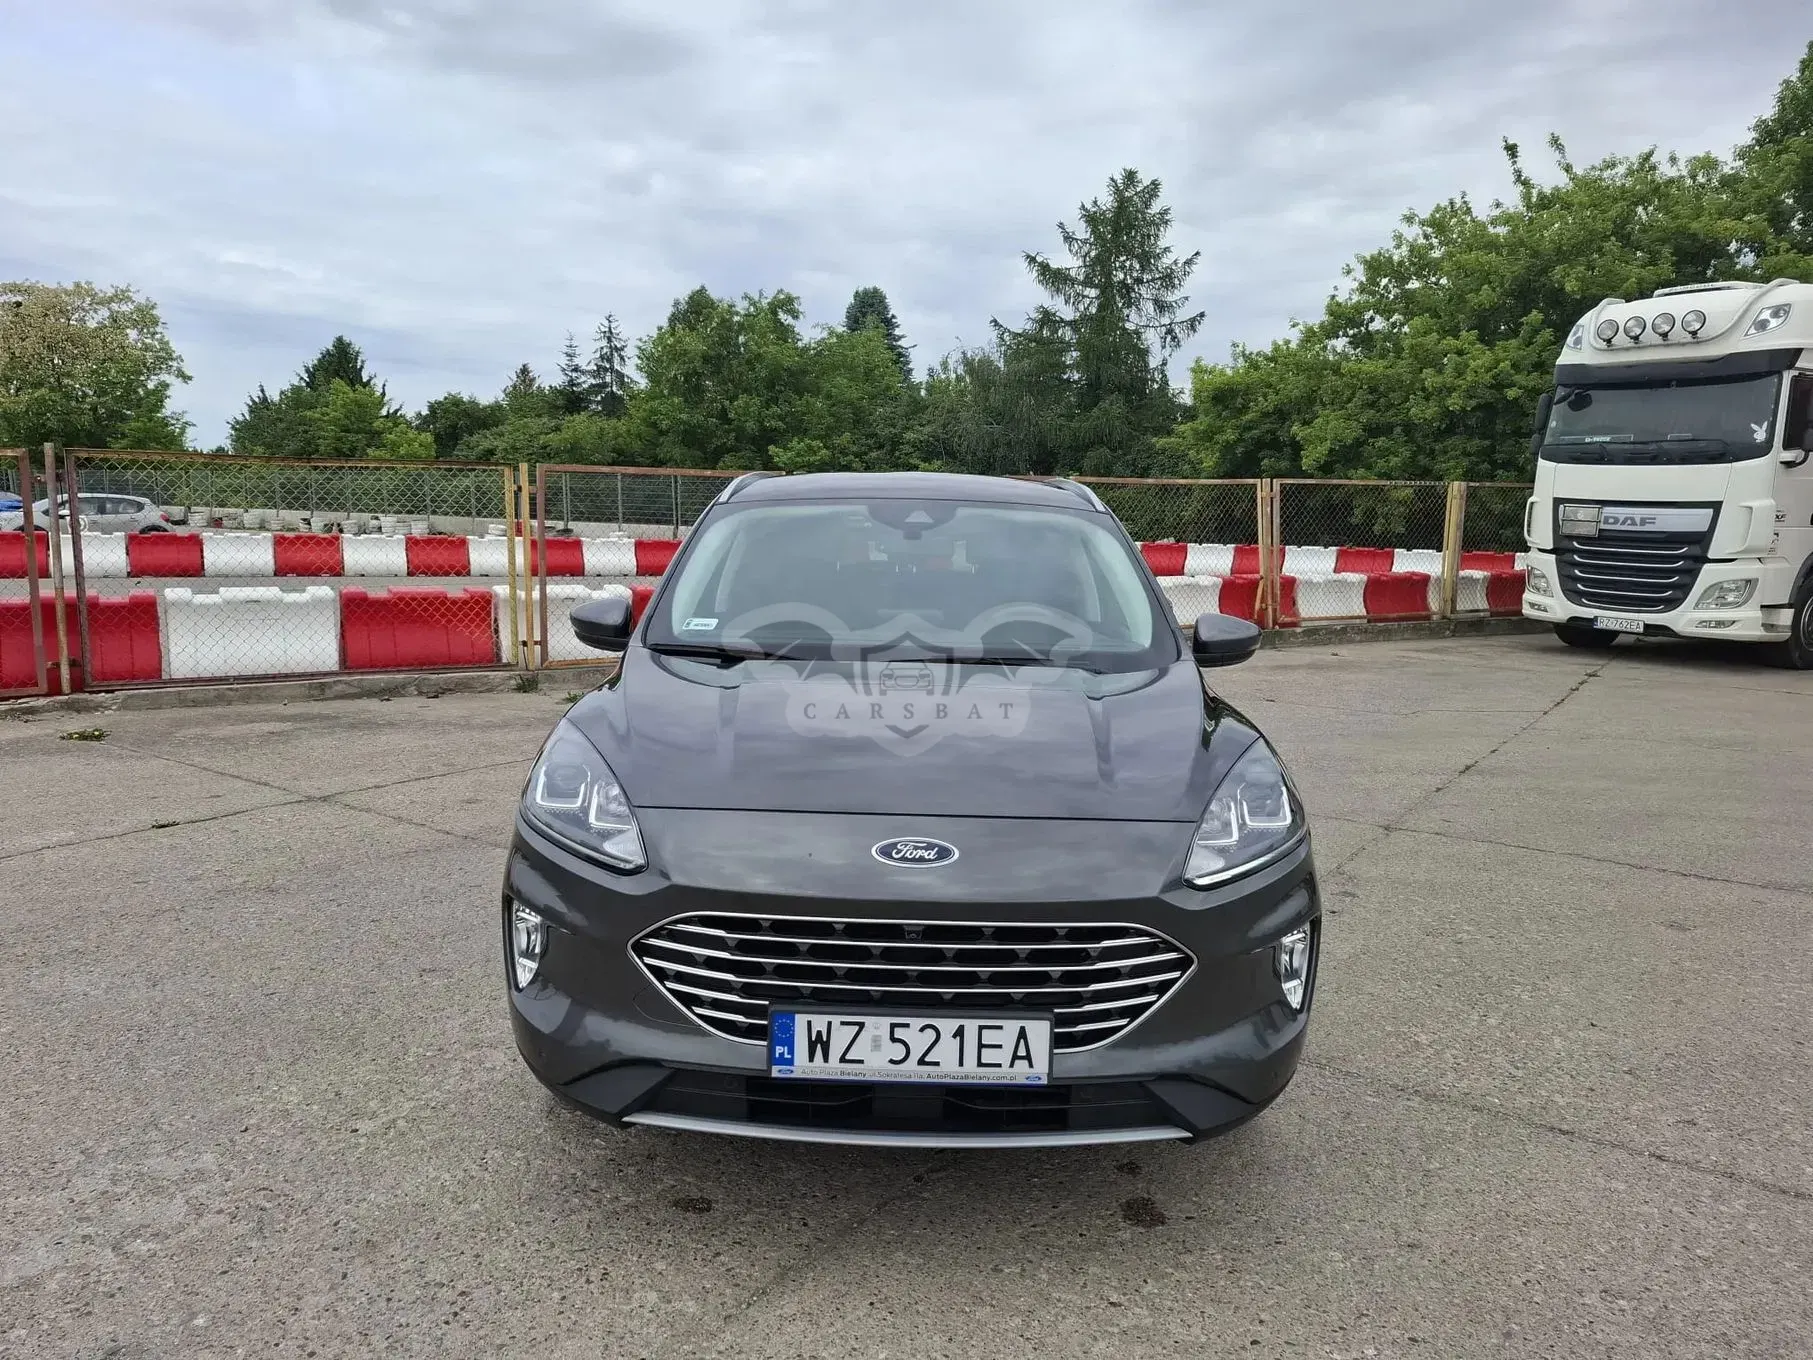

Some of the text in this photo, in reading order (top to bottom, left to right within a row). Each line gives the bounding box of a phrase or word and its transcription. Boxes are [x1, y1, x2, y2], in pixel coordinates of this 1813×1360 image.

[1603, 515, 1656, 527] DAF
[1599, 618, 1641, 631] RZ 762EA
[891, 841, 939, 859] Ford
[806, 1020, 1035, 1069] WZ 521EA
[775, 1046, 791, 1059] PL
[840, 1070, 866, 1079] Bielany
[926, 1073, 1017, 1082] AutoPlazaBielany.com.pl
